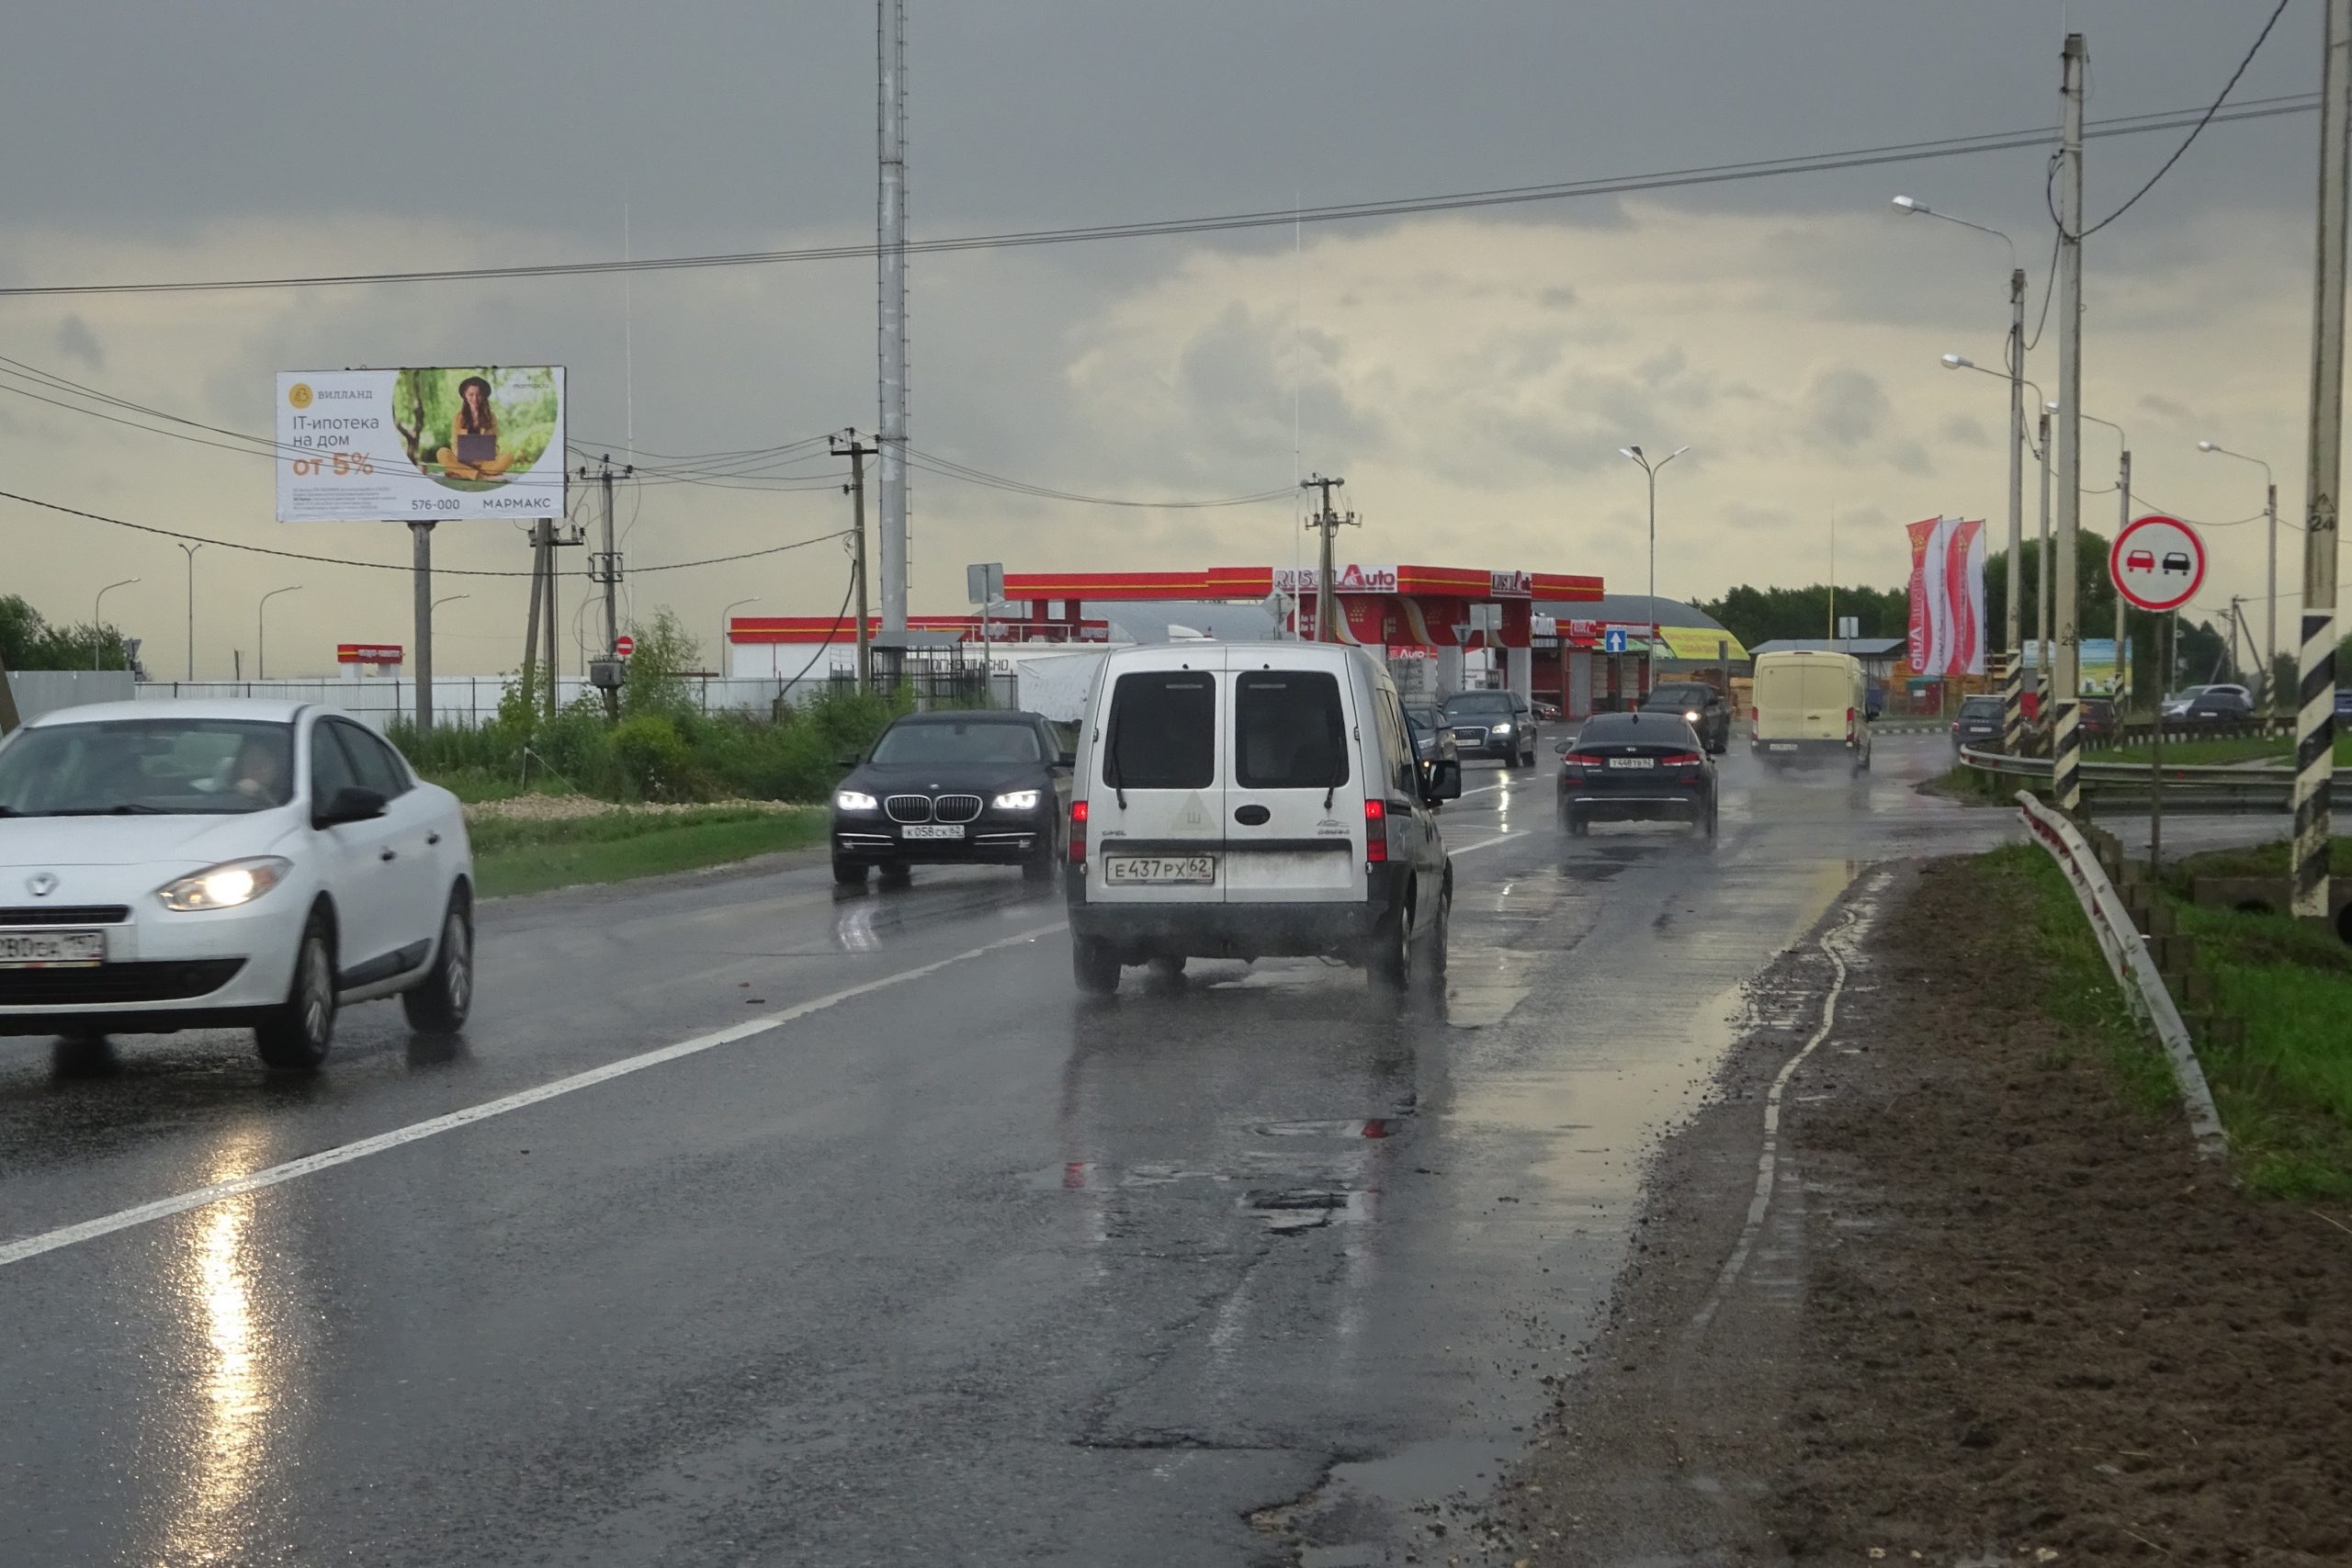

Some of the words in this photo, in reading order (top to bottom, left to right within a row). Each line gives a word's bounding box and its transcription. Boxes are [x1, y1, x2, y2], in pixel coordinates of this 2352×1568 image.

[317, 390, 373, 400] ВИЛЛАНД
[292, 415, 379, 430] IT-ипотека
[293, 435, 312, 447] на
[317, 434, 349, 448] дом
[292, 458, 323, 476] от
[333, 451, 374, 476] 5%
[412, 499, 460, 511] 576-000
[482, 497, 551, 509] МАРМАКС
